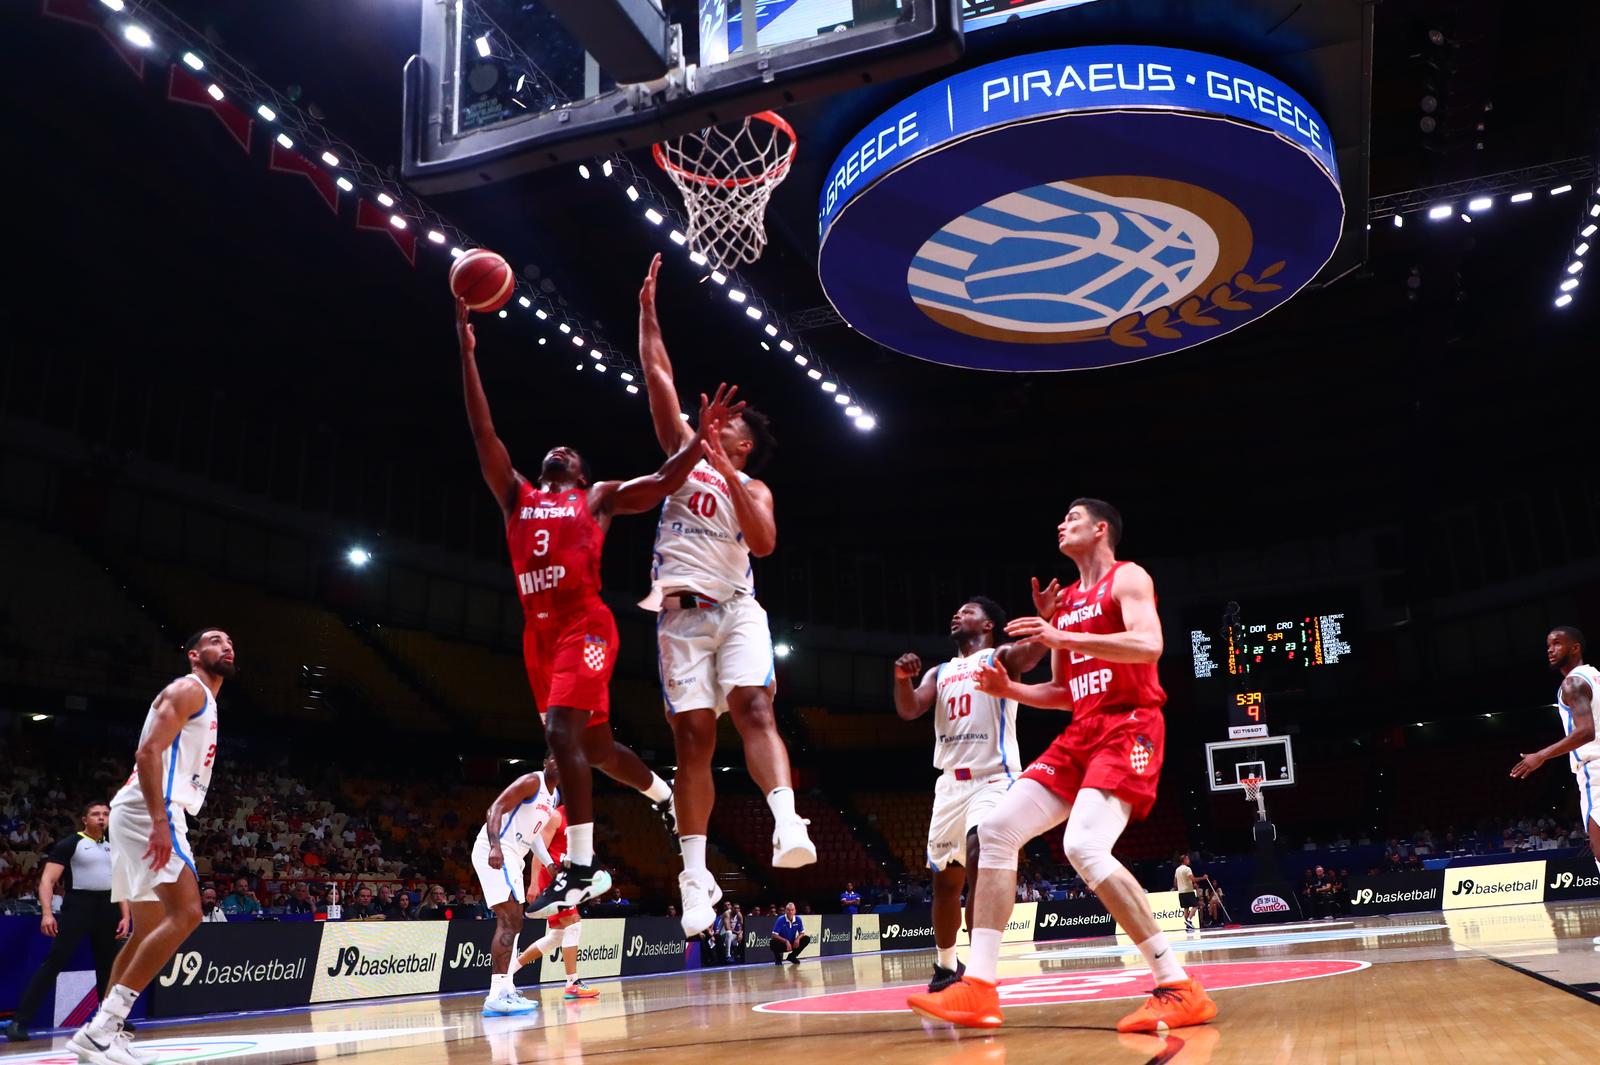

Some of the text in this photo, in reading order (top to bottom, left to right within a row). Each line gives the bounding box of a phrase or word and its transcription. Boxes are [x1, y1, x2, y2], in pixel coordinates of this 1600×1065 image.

[982, 62, 1324, 151] PIRAEUS GREECE
[825, 111, 919, 217] GREECE
[520, 505, 576, 520] HRVATSKA
[688, 491, 717, 519] 40
[533, 529, 551, 556] 3
[1250, 625, 1266, 633] DOM
[1276, 621, 1293, 630] CRO
[1267, 632, 1283, 641] 5:39
[1253, 646, 1264, 654] 22
[1285, 642, 1296, 651] 23
[947, 693, 972, 721] 10
[1236, 692, 1262, 706] 5:39
[1248, 706, 1259, 721] 9
[1452, 879, 1538, 896] J9.basketball
[1351, 887, 1437, 906] J9.basketball
[1039, 913, 1112, 928] J9.basketball
[626, 934, 686, 958] J9.basketball
[158, 950, 306, 988] J9.basketball
[327, 945, 437, 979] J9.basketball
